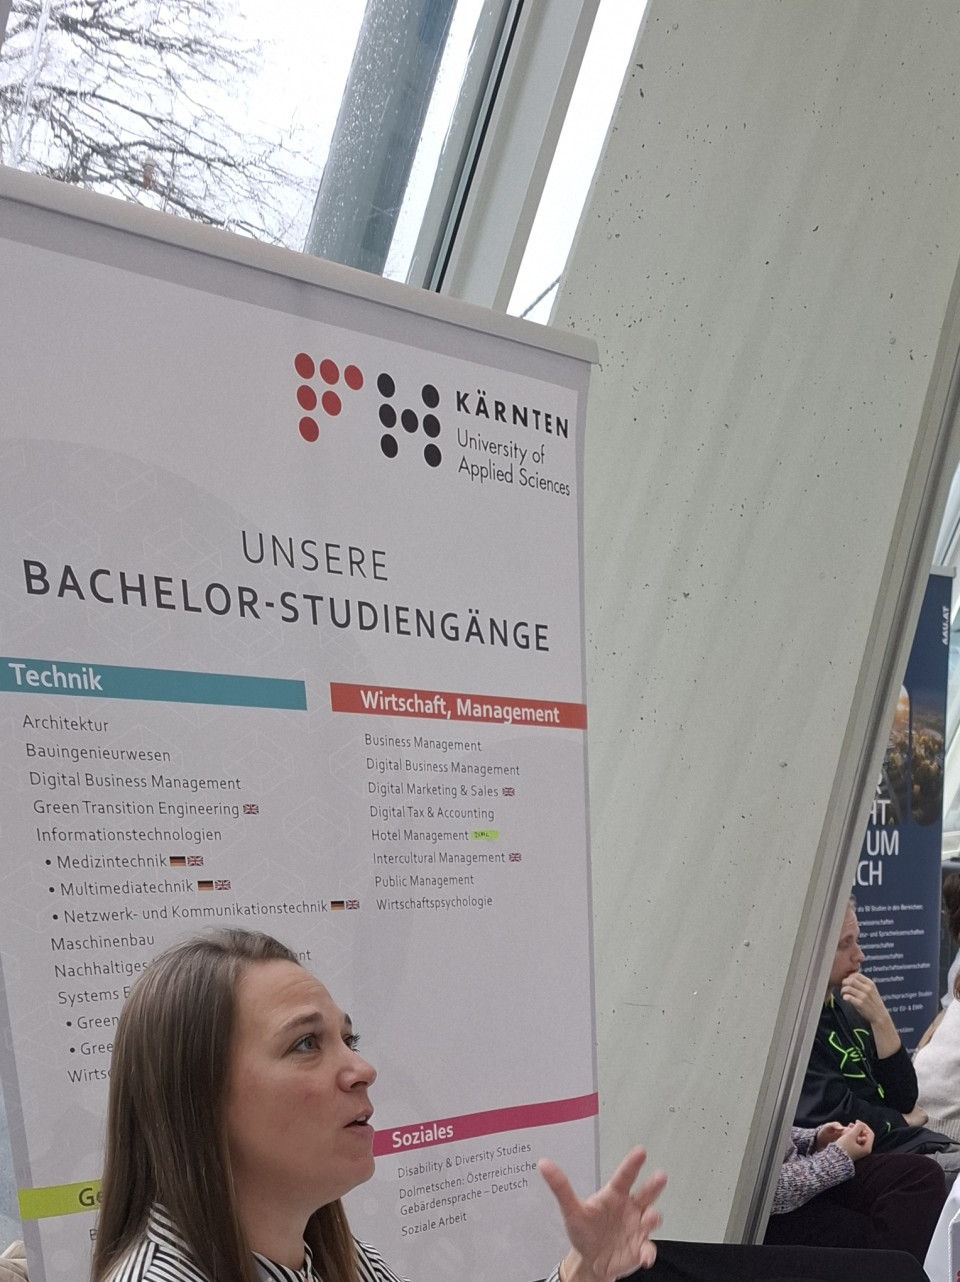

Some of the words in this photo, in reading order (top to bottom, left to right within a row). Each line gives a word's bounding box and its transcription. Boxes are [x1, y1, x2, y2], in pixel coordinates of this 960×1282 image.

[456, 389, 569, 439] KÄRNTEN
[456, 428, 528, 466] University
[531, 445, 546, 465] of
[457, 456, 514, 484] Applied
[519, 467, 571, 497] Sciences
[241, 530, 389, 581] UNSERE
[23, 558, 550, 653] BACHELOR-STUDIENGÄNGE
[9, 663, 104, 691] Technik
[360, 690, 452, 720] Wirtschaft,
[456, 698, 560, 724] Management
[23, 715, 109, 733] Architektur
[364, 733, 411, 748] Business
[413, 736, 482, 752] Management
[26, 743, 172, 763] Bauingenieurwesen
[366, 758, 402, 774] Digital
[405, 759, 449, 773] Business
[451, 762, 520, 778] Management
[29, 771, 80, 790] Digital
[85, 773, 147, 788] Business
[151, 775, 242, 792] Management
[368, 782, 404, 797] Digital
[406, 783, 457, 798] Marketing
[460, 785, 468, 796] &
[470, 785, 499, 797] Sales
[33, 800, 80, 815] Green
[82, 800, 154, 815] Transition
[158, 802, 240, 819] Engineering
[370, 806, 406, 821] Digital
[407, 807, 425, 818] Tax
[427, 808, 435, 818] &
[437, 807, 495, 822] Accounting
[36, 827, 222, 845] Informationstechnologien
[371, 829, 401, 841] Hotel
[403, 829, 469, 844] Management
[57, 854, 167, 869] Medizintechnik
[373, 852, 436, 865] Intercultural
[439, 852, 506, 866] Management
[60, 881, 194, 897] Multimediatechnik
[375, 875, 408, 888] Public
[410, 874, 474, 889] Management
[64, 909, 139, 923] Netzwerk-
[142, 908, 168, 920] und
[172, 901, 328, 919] Kommunikationstechnik
[377, 896, 493, 911] Wirtschaftspsychologie
[51, 934, 155, 951] Maschinenbau
[54, 960, 148, 979] Nachhaltiges
[58, 988, 120, 1007] Systems
[80, 1042, 114, 1056] Gree
[392, 1124, 454, 1149] Soziales
[398, 1160, 443, 1179] Disability
[446, 1157, 453, 1168] &
[455, 1151, 495, 1167] Diversity
[497, 1143, 532, 1158] Studies
[399, 1178, 465, 1199] Dolmetschen:
[466, 1161, 537, 1184] Österreichische
[401, 1190, 483, 1216] Gebärdensprache
[491, 1178, 528, 1195] Deutsch
[401, 1220, 437, 1237] Soziale
[438, 1212, 467, 1228] Arbeit
